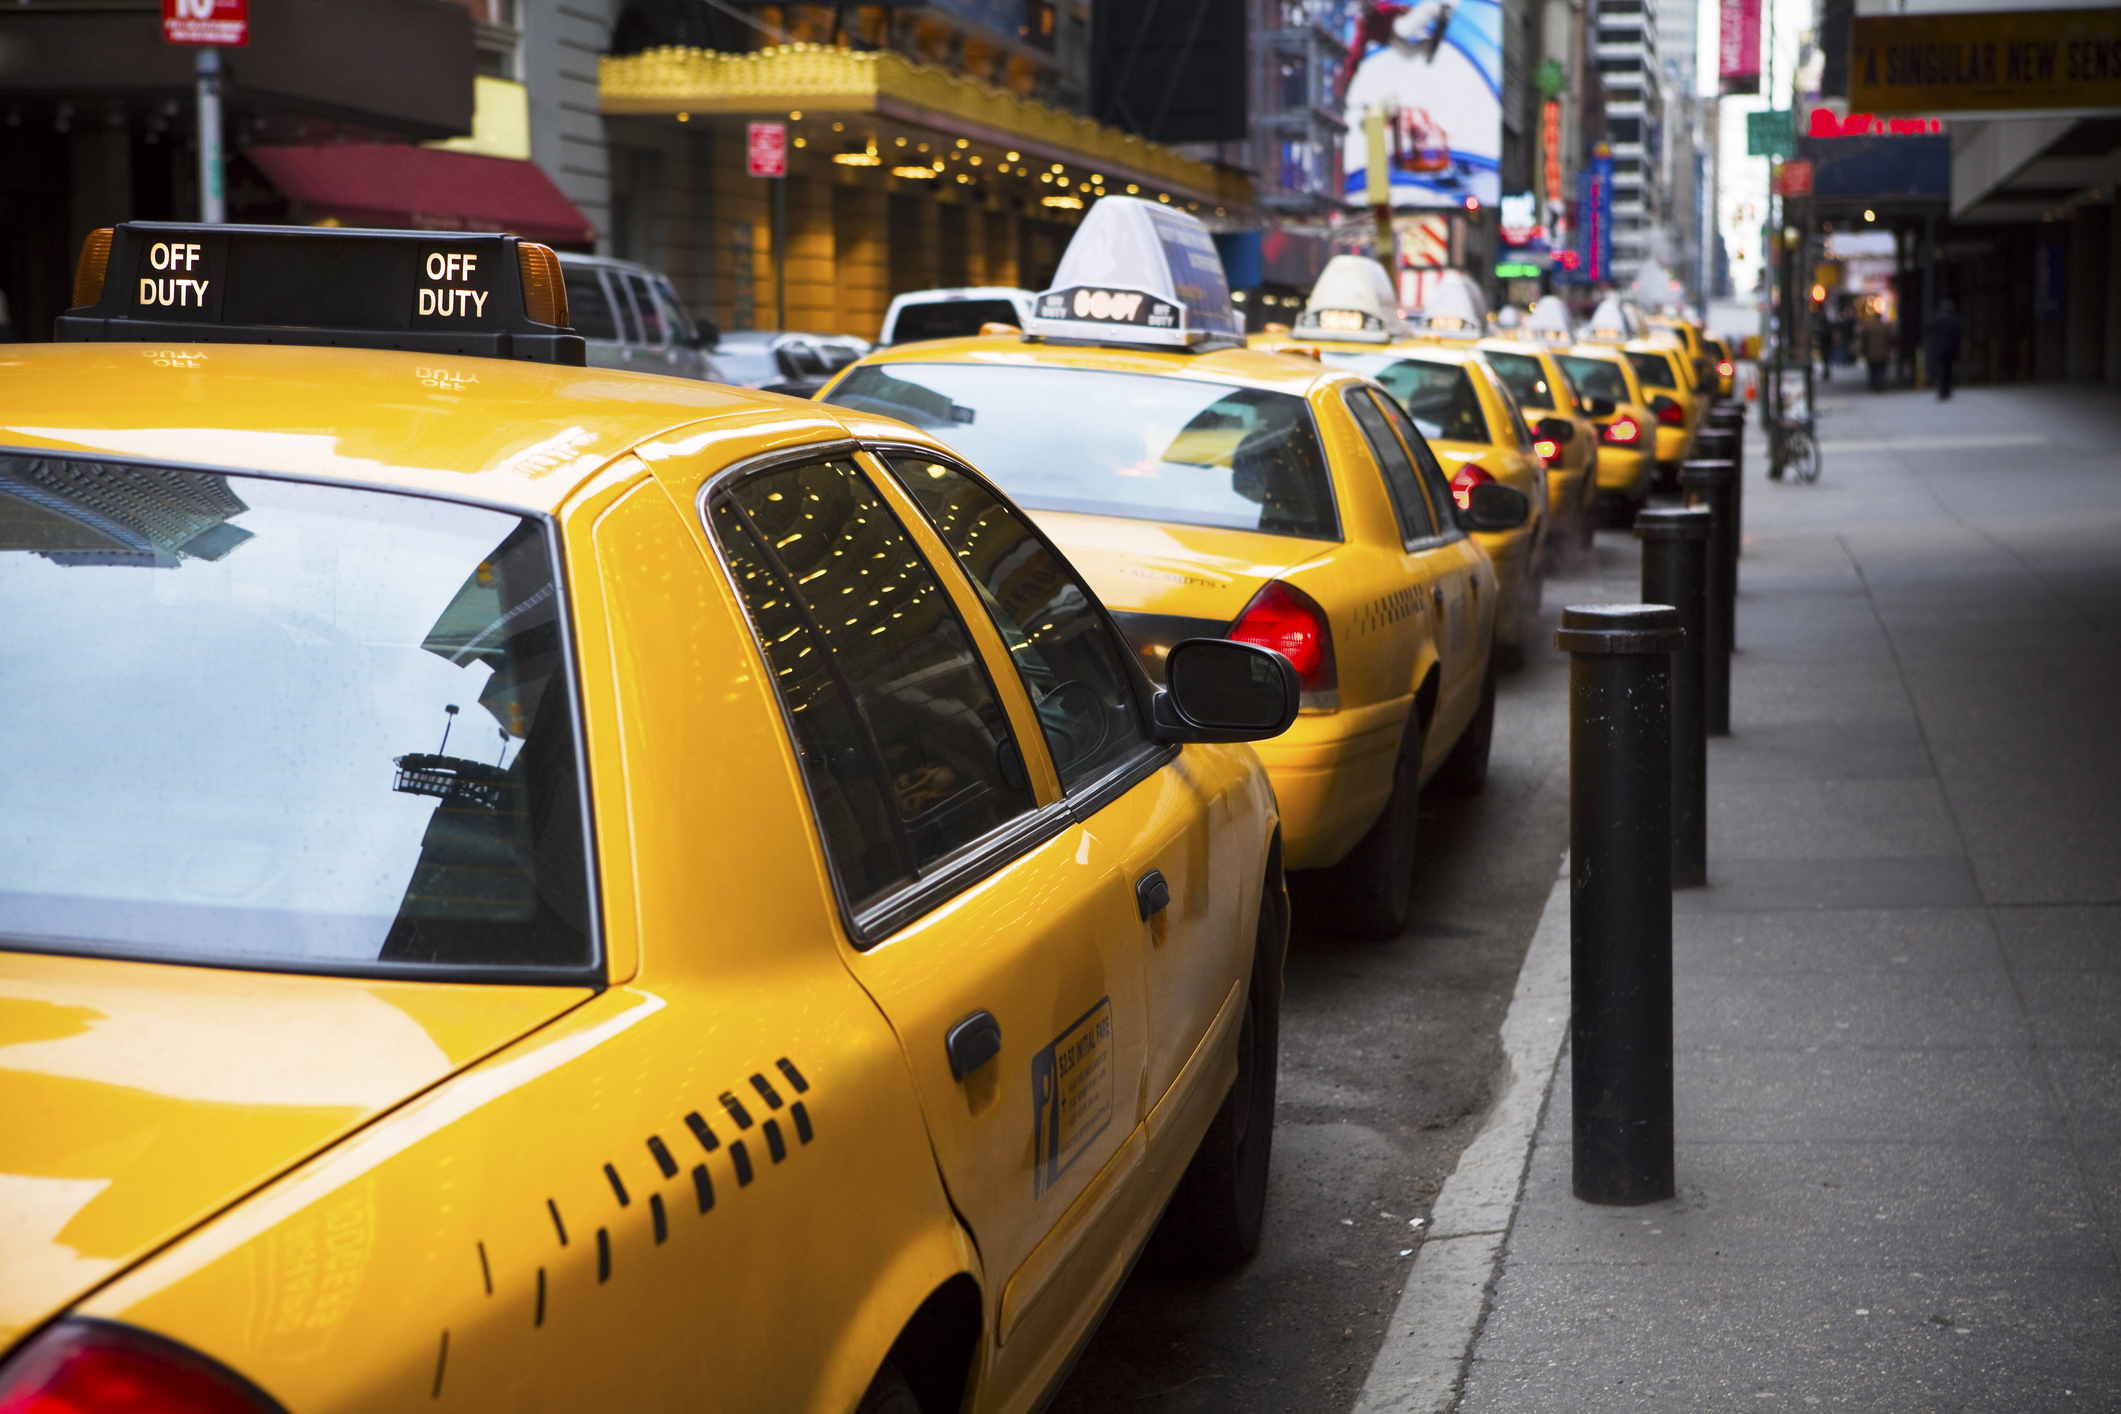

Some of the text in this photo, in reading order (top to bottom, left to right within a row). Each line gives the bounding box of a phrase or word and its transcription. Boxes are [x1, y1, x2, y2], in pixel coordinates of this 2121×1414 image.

[1886, 43, 1997, 86] SINGULAR
[2007, 42, 2057, 83] NEW
[150, 242, 201, 271] OFF
[426, 252, 478, 282] OFF
[140, 278, 209, 307] DUTY
[418, 288, 489, 318] DUTY
[1130, 568, 1216, 588] ALL SHIFTS
[1075, 1029, 1096, 1063] INITIAL
[1096, 1015, 1110, 1044] FARE
